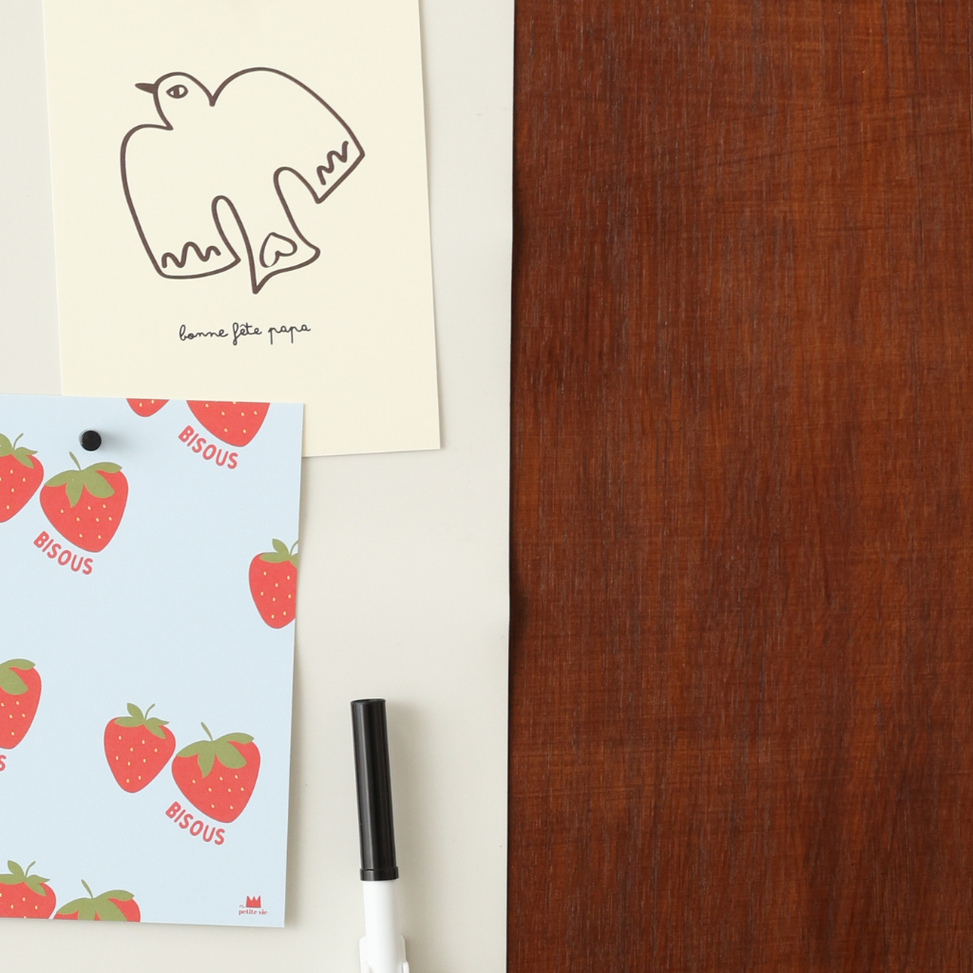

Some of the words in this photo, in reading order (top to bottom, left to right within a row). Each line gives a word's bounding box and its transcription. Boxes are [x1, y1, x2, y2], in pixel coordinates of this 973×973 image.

[179, 324, 229, 341] bonne
[232, 322, 262, 346] fête
[268, 324, 311, 345] papa
[178, 424, 239, 470] BISOUS
[33, 530, 94, 576] BISOUS
[165, 801, 226, 846] BISOUS
